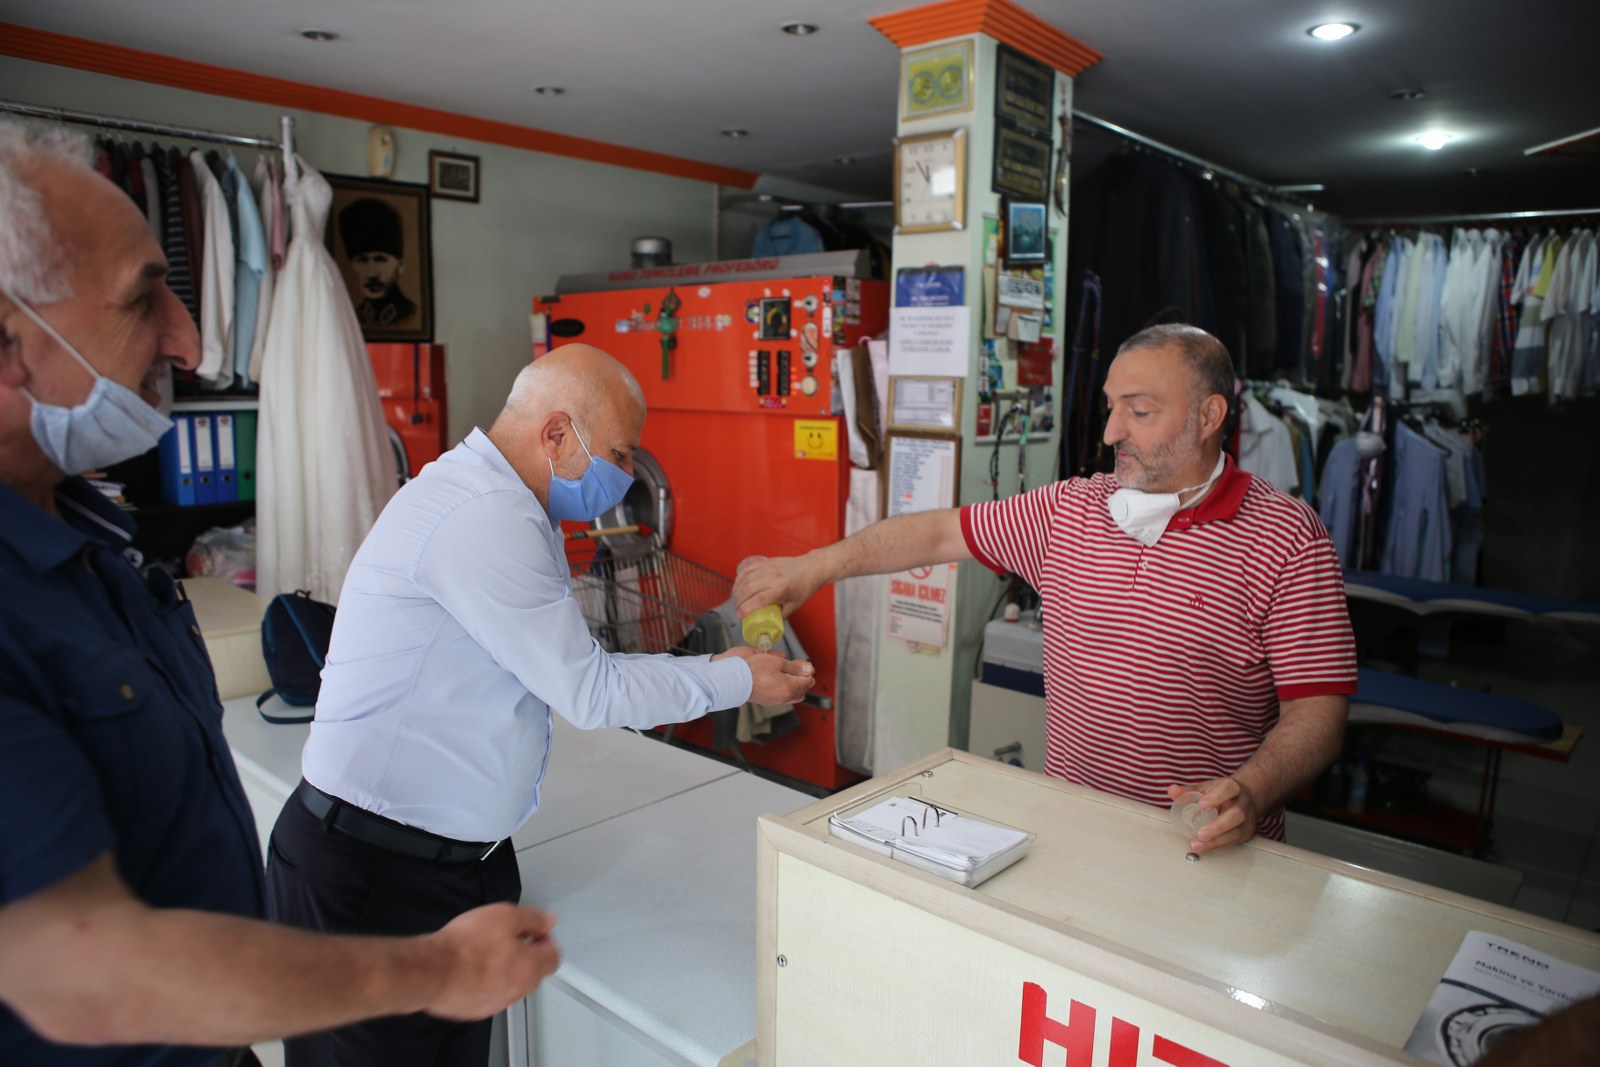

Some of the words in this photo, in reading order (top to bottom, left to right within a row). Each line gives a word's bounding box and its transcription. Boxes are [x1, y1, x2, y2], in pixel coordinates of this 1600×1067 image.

[1475, 960, 1517, 980] Makina
[1520, 977, 1535, 987] ve
[1019, 981, 1231, 1067] HI
